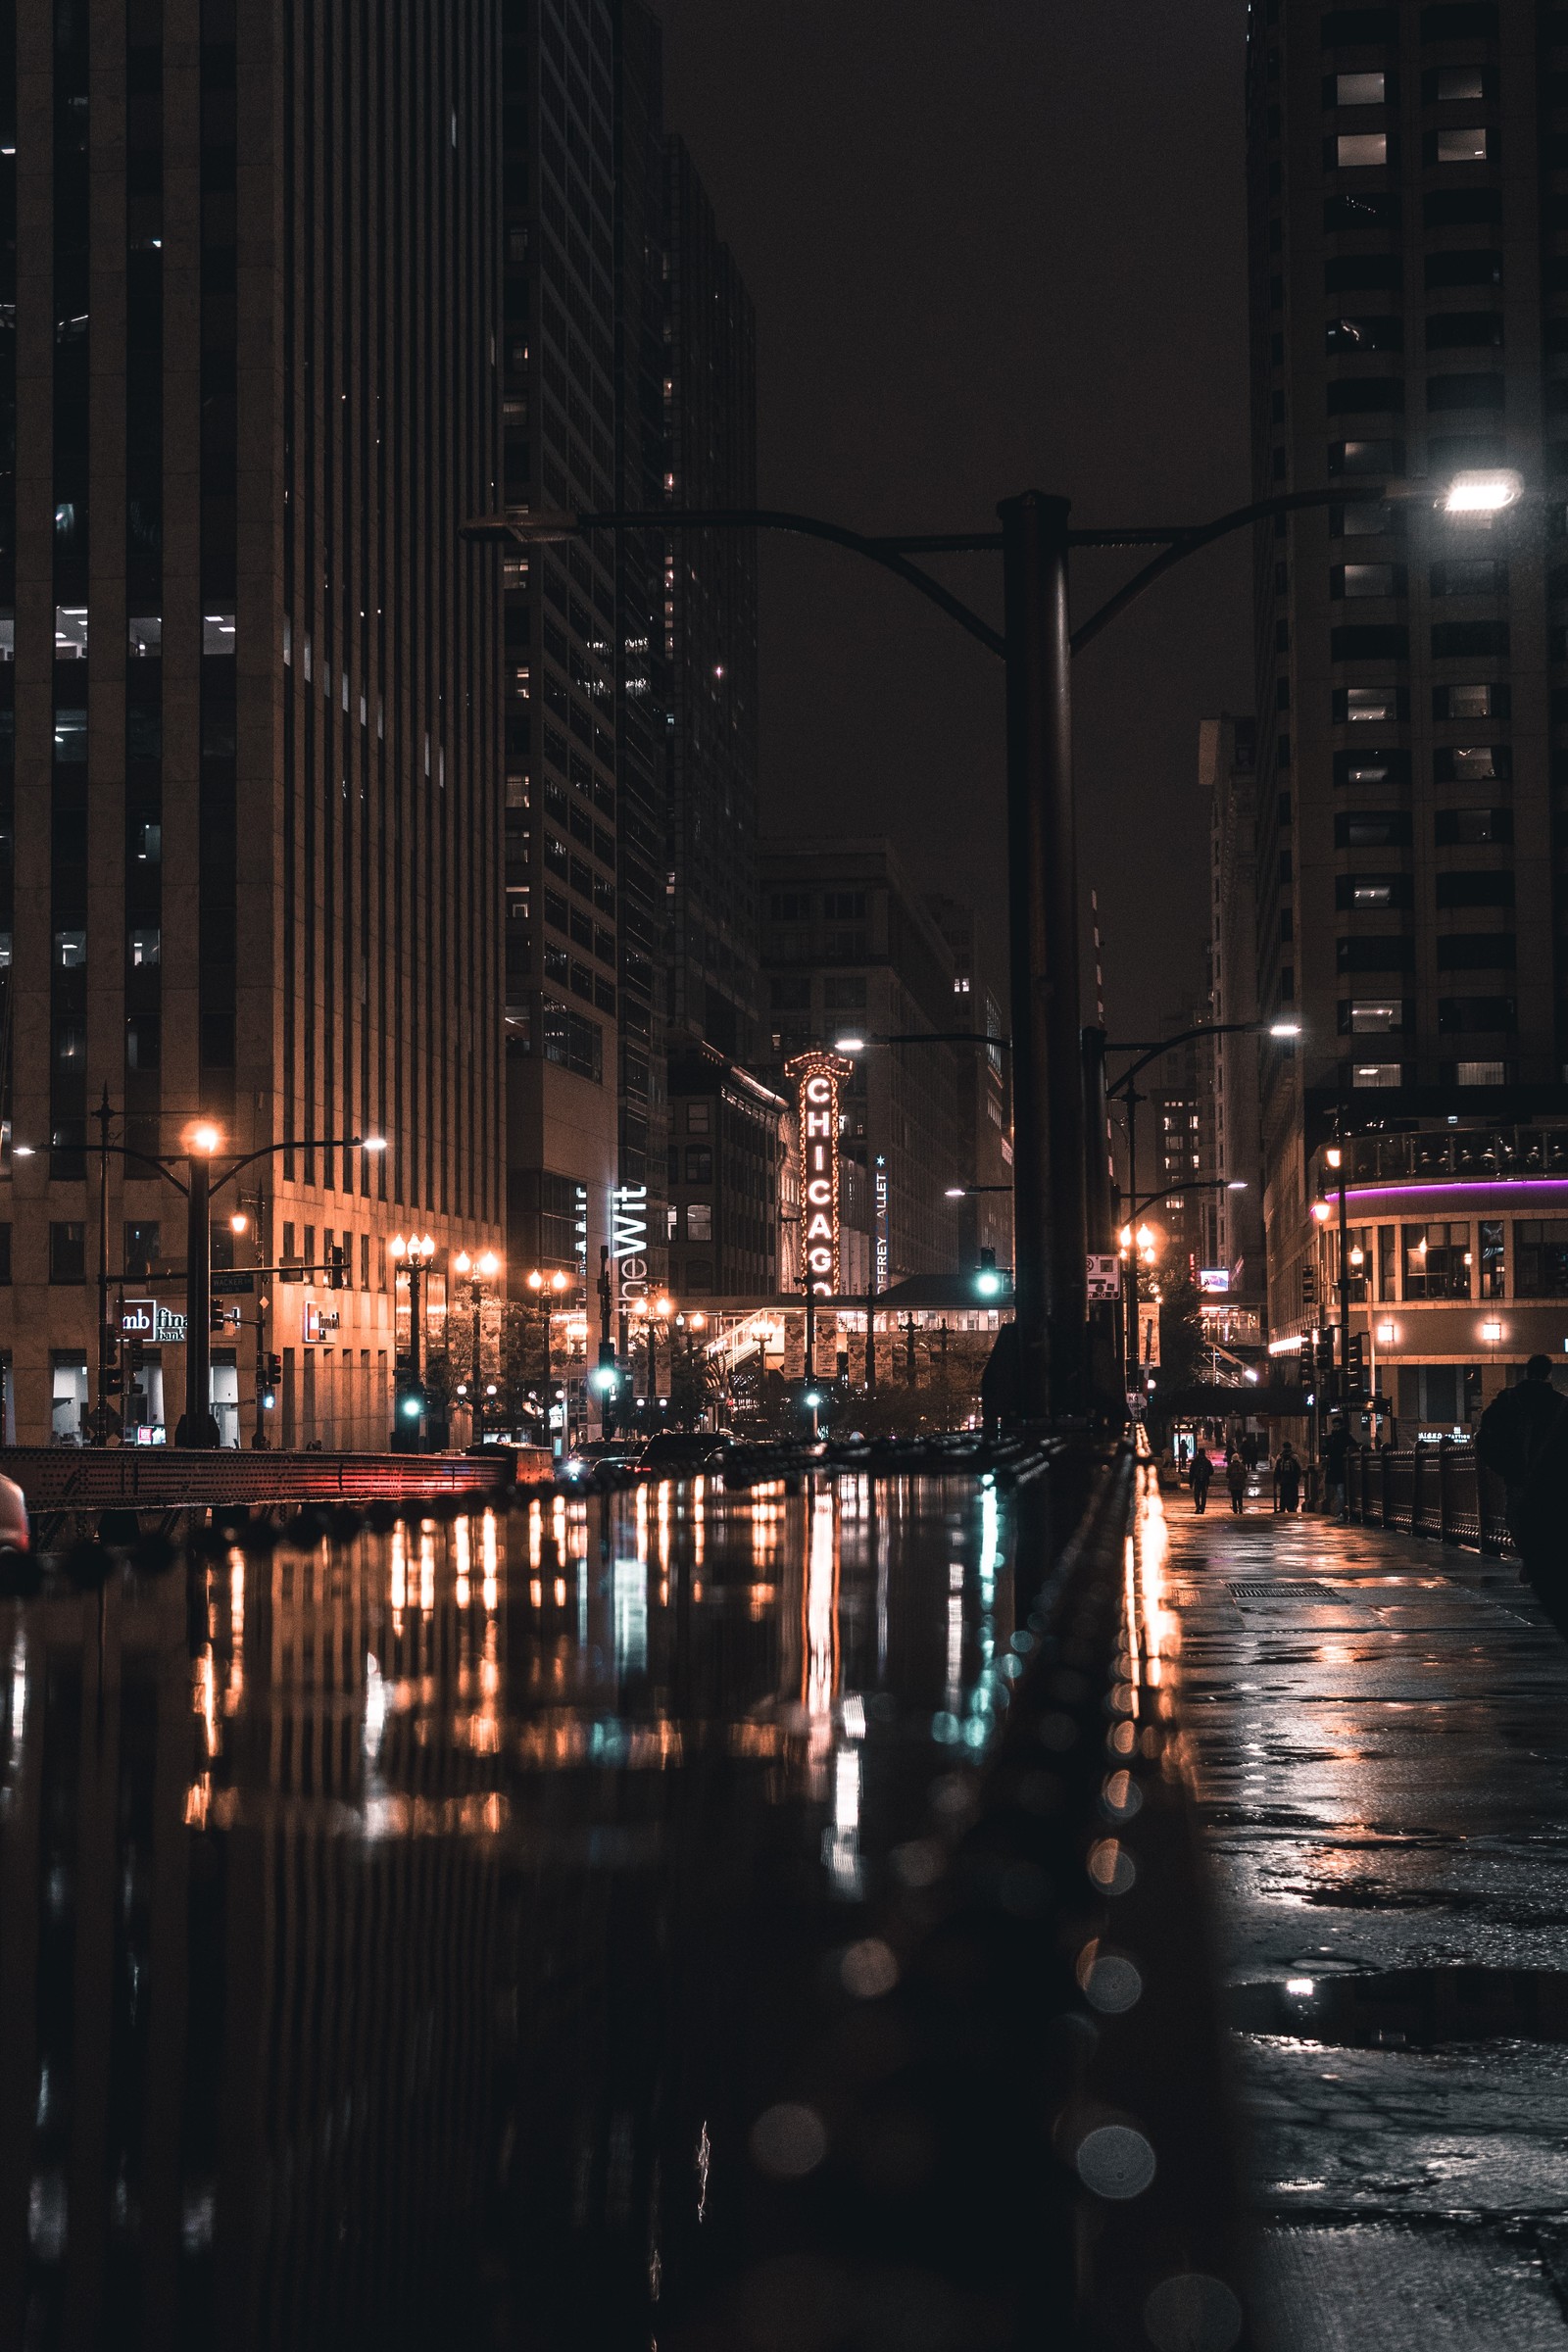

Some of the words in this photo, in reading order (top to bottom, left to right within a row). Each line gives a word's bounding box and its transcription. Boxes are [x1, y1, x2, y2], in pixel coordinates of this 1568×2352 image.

[807, 1078, 833, 1297] CHICAGO
[876, 1172, 888, 1219] ALLET
[213, 1278, 243, 1287] WACKER
[876, 1235, 888, 1295] OFFREY
[157, 1329, 185, 1341] bank
